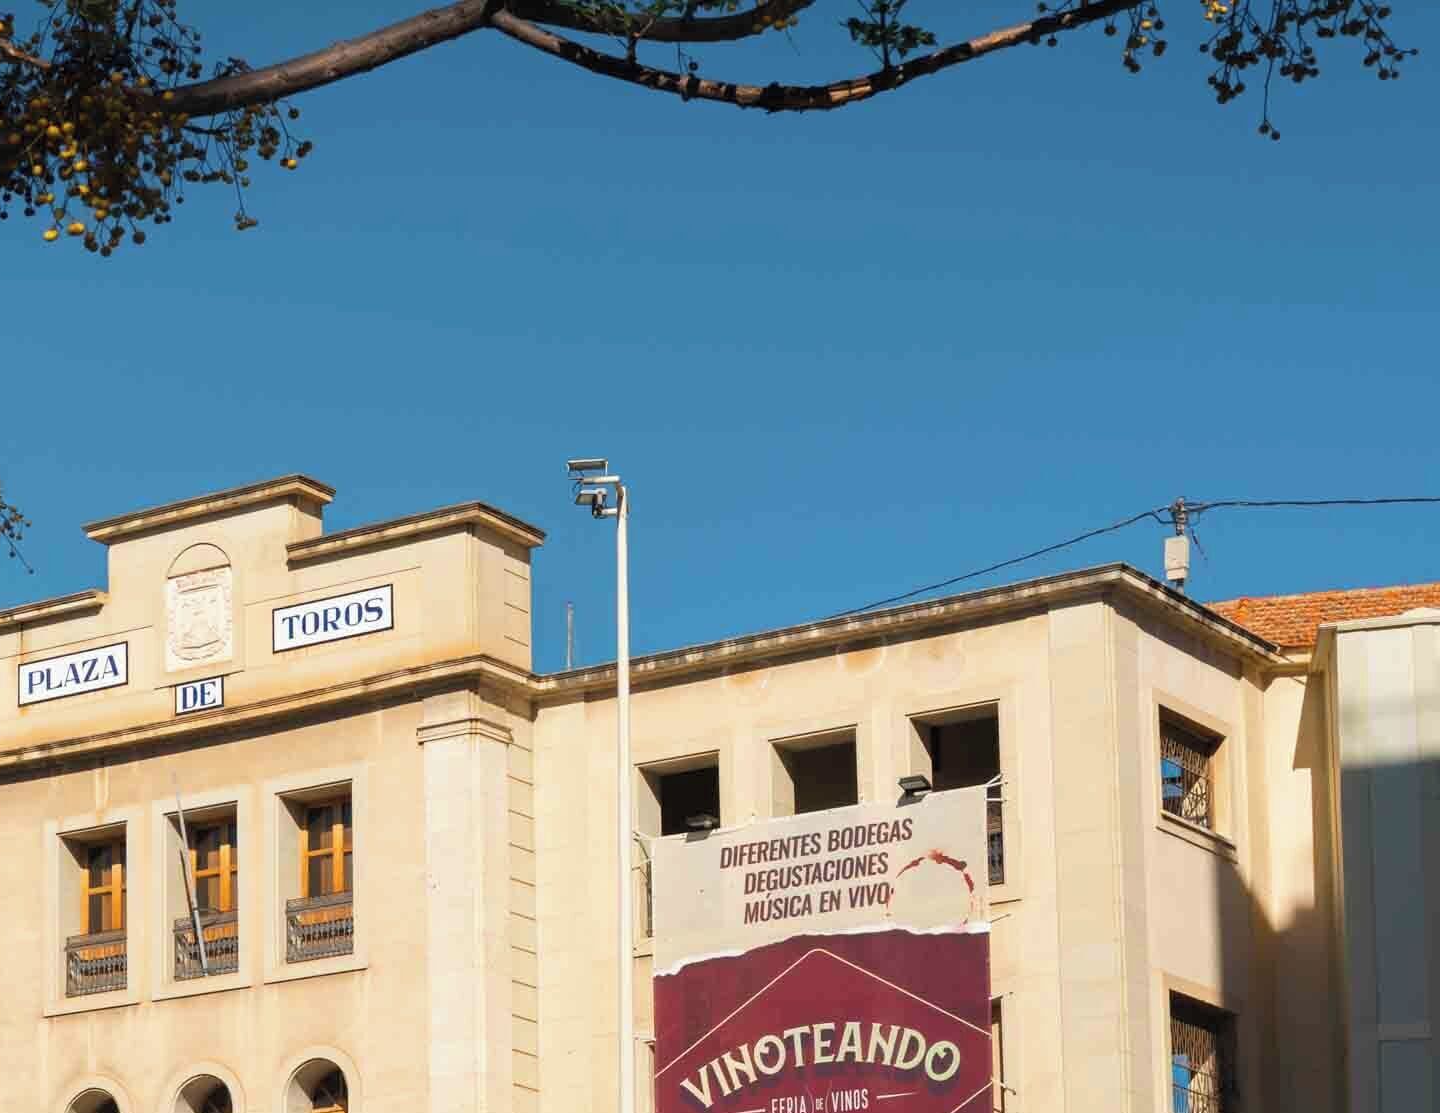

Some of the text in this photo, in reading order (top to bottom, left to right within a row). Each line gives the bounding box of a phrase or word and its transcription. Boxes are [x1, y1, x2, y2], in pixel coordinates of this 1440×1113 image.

[281, 596, 384, 641] TOROS
[27, 654, 120, 695] PLAZA
[181, 681, 217, 711] DE
[720, 818, 913, 869] DIFERENTES BODEGAS
[744, 852, 889, 895] DEGUSTACIONES
[743, 882, 890, 925] MÚSICA EN VIVO
[680, 1021, 960, 1109] VINOTEANDO
[815, 1097, 824, 1111] DE
[831, 1088, 869, 1113] VINOS
